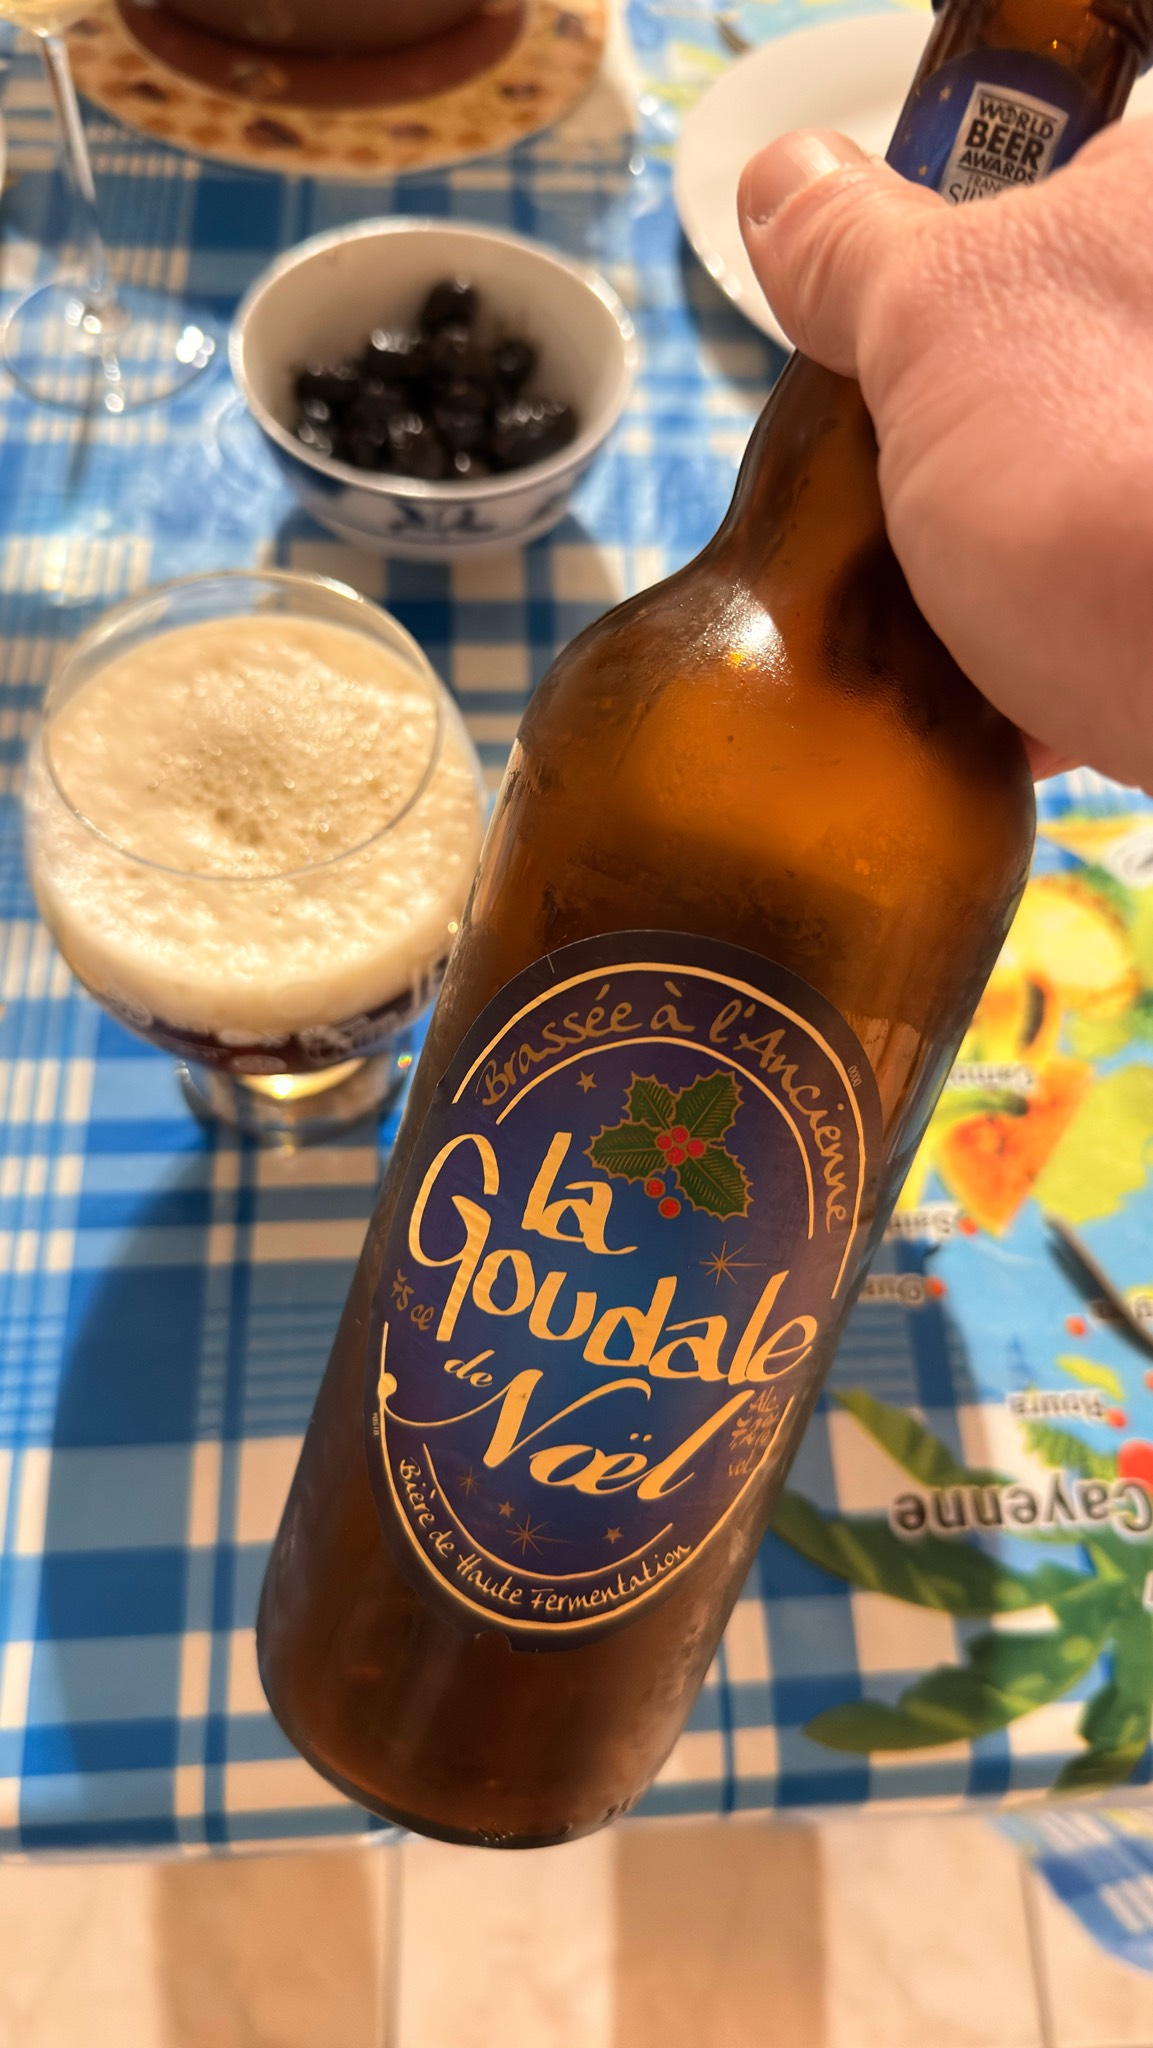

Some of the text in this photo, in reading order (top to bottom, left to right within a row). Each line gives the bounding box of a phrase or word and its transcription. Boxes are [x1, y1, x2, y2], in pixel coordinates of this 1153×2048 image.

[965, 118, 1045, 171] BEER
[978, 100, 1054, 140] WORLD
[966, 174, 1003, 194] FRAN
[476, 983, 643, 1106] Brassée
[650, 981, 697, 1033] à
[709, 1001, 848, 1234] l'Ancienne
[521, 1131, 639, 1255] la
[408, 1133, 819, 1386] Goudale
[443, 1349, 755, 1500] de Noël
[400, 1457, 691, 1613] Bière de Haute Fermentation
[898, 1473, 1152, 1533] Cayenne
